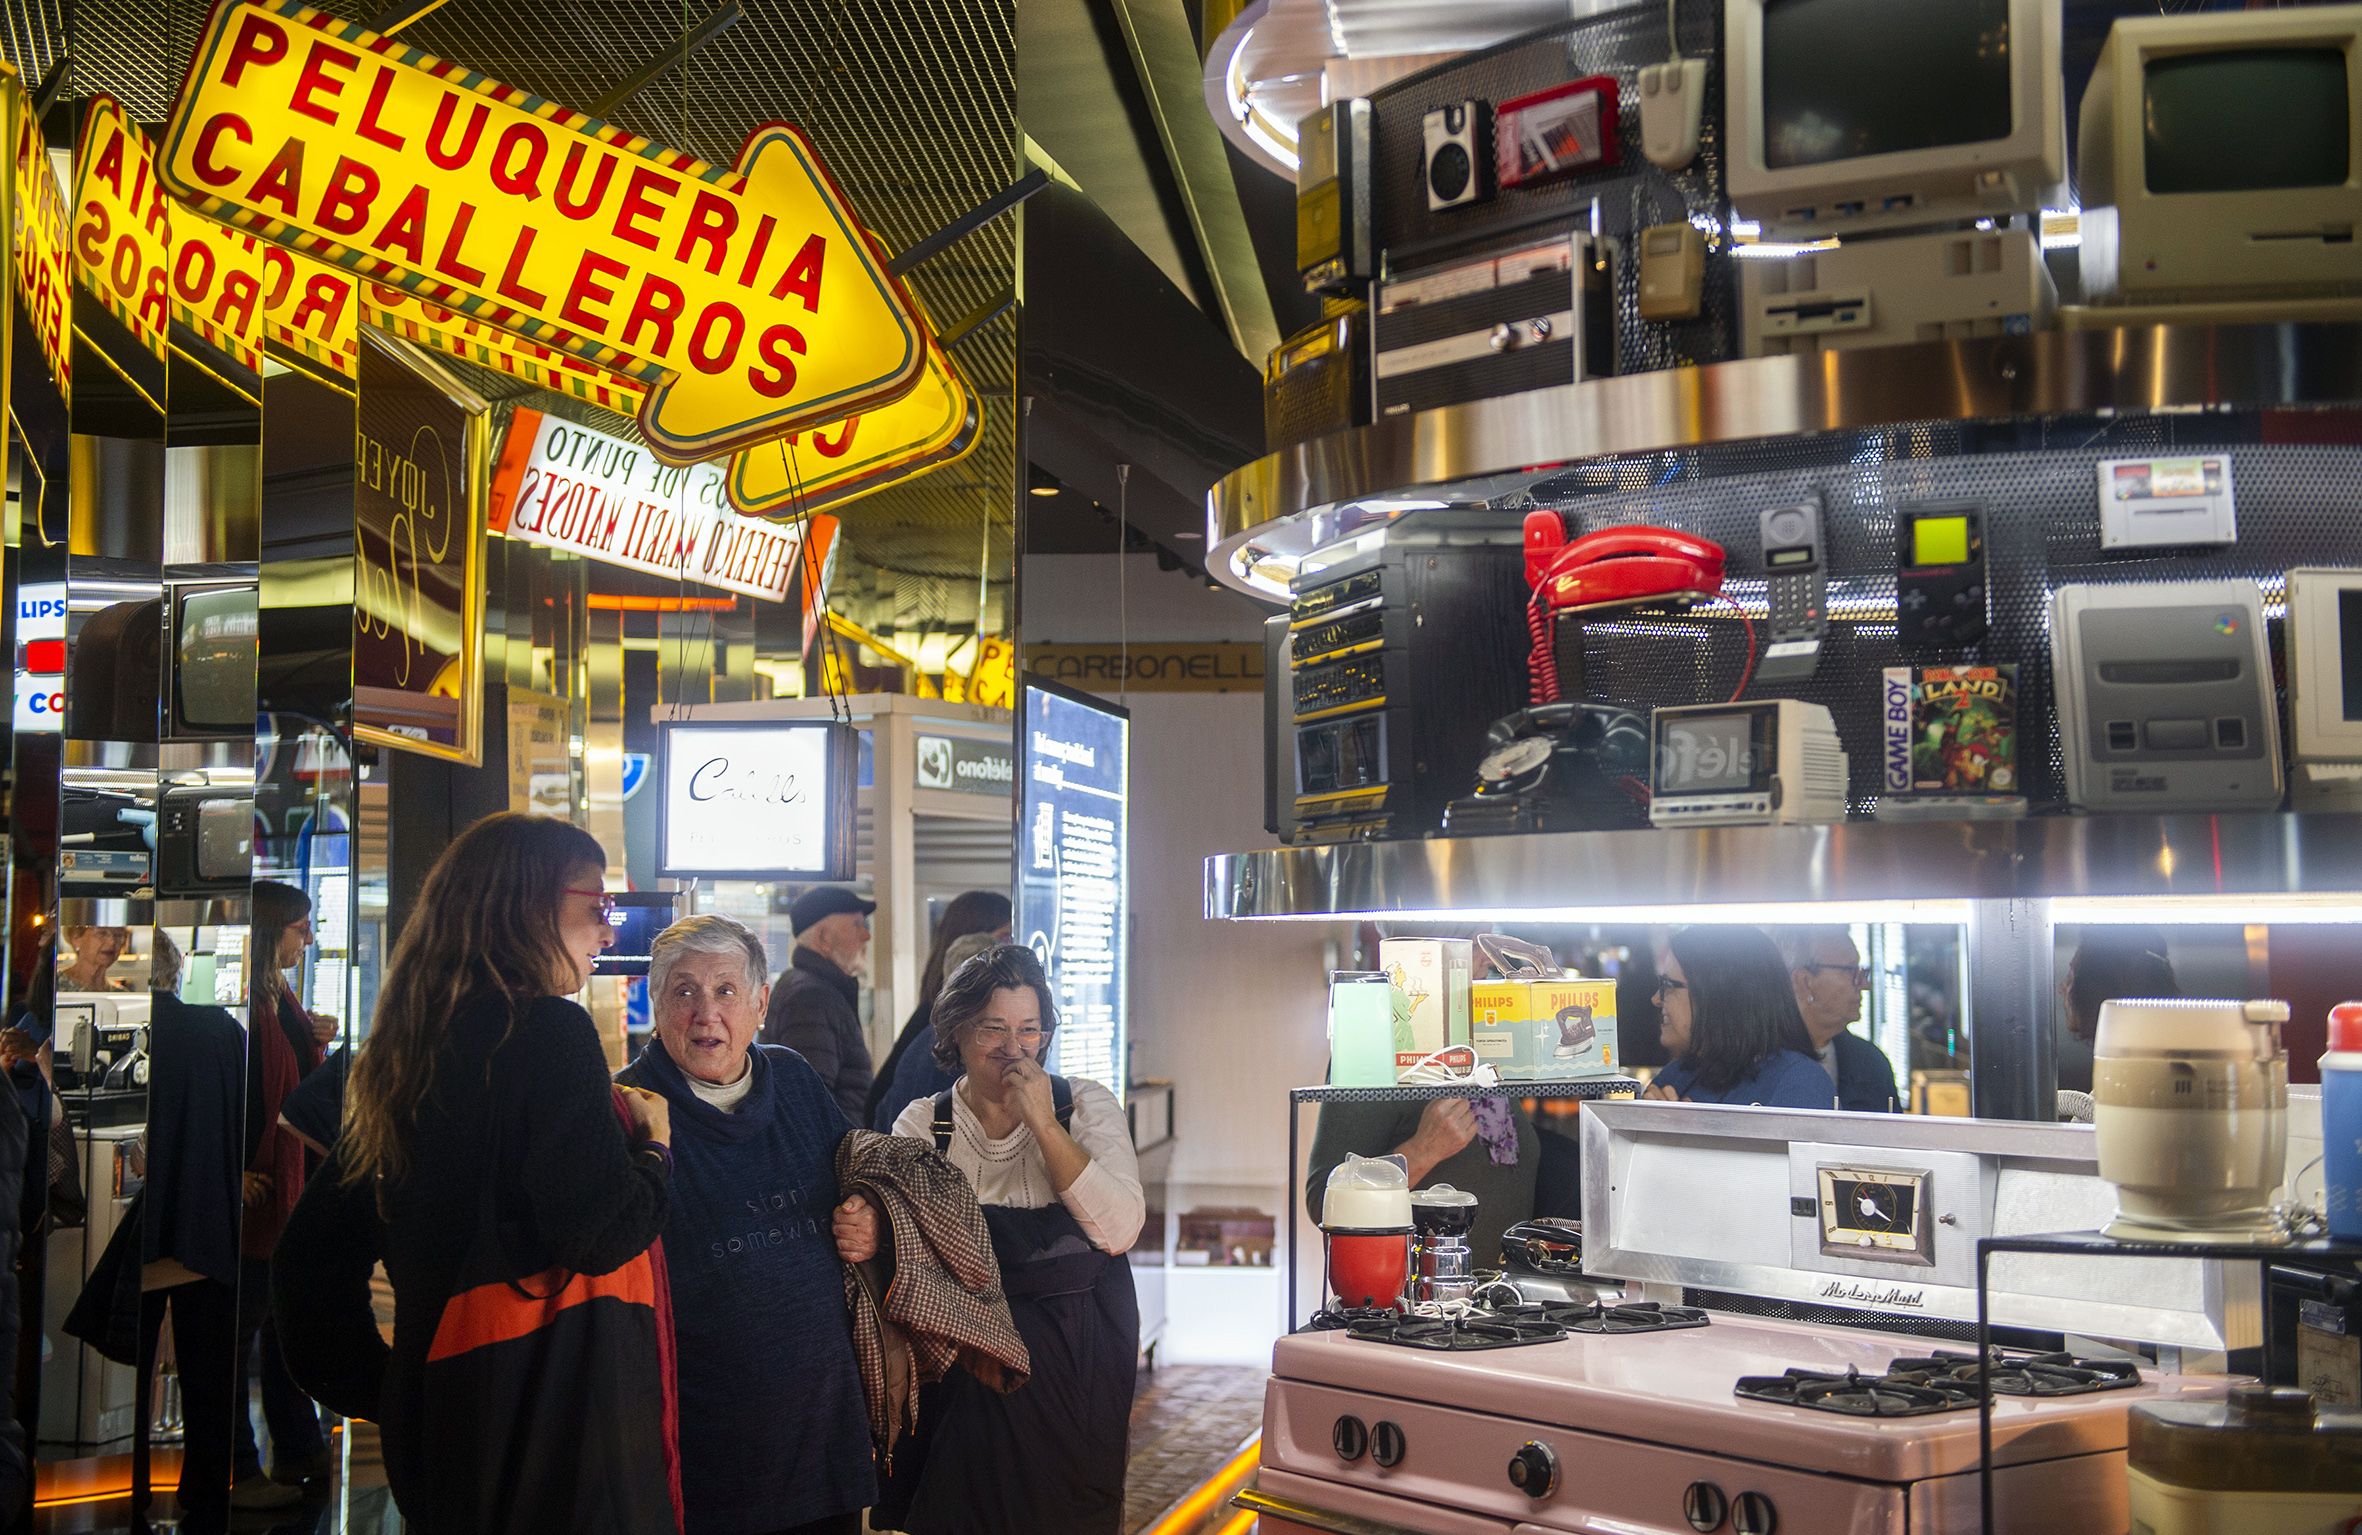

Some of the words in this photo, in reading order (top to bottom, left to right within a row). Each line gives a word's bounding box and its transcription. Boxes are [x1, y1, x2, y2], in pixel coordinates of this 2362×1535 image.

[220, 13, 827, 315] PELUQUERIA
[190, 112, 808, 398] CABALLEROS
[1032, 655, 1264, 680] CARBONELL
[1888, 680, 1908, 722] BOY
[1925, 680, 2000, 700] LAND
[1952, 688, 1971, 709] 2
[1888, 726, 1908, 790] GAME
[1551, 991, 1599, 1010] PHILIPS
[746, 1179, 809, 1214] start
